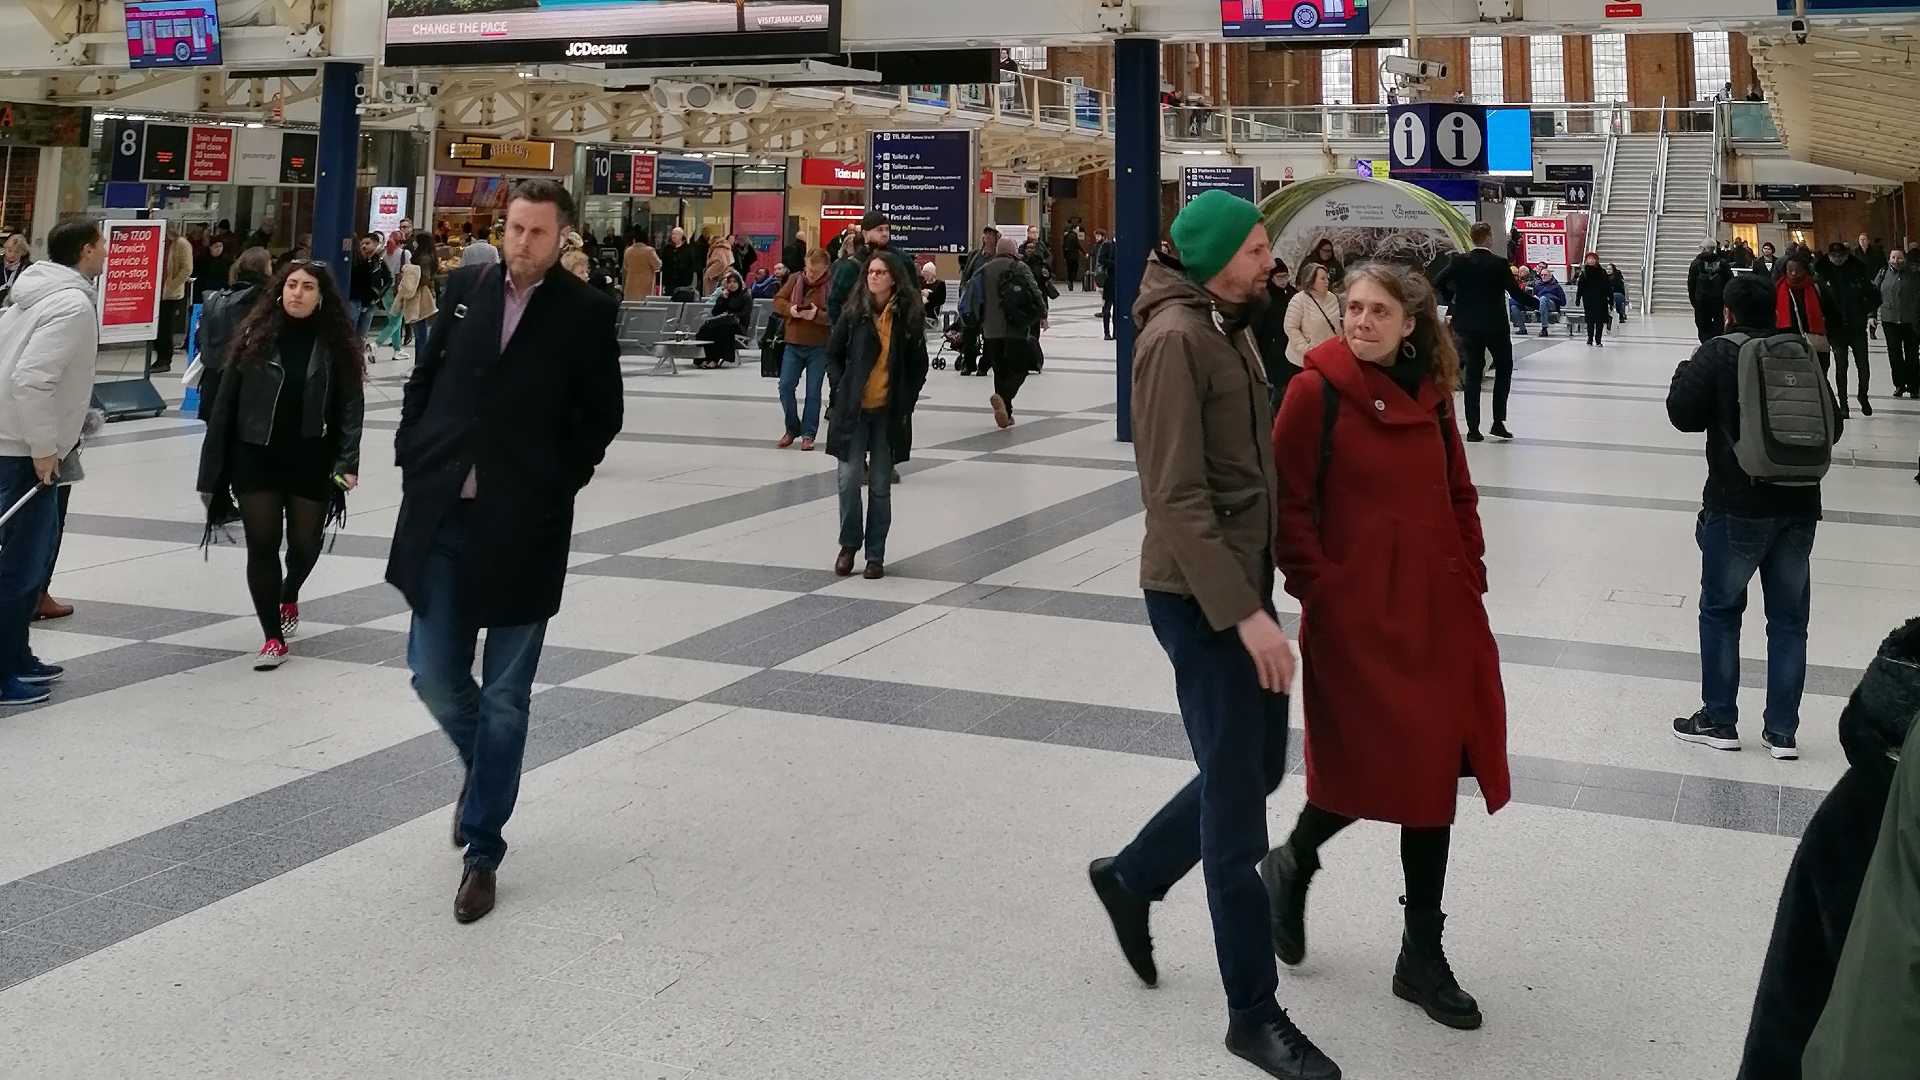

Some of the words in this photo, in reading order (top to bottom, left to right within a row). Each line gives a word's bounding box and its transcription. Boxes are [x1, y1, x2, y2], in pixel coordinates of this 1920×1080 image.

[758, 14, 822, 24] VISITJAMAICA.COM
[412, 23, 455, 35] CHANGE
[459, 22, 478, 34] THE
[480, 21, 508, 32] PACE
[566, 42, 628, 56] JCDecaux
[120, 128, 136, 156] 8
[594, 158, 608, 176] 10
[834, 168, 851, 179] Tickets
[112, 230, 129, 241] The
[110, 242, 146, 254] Norwich
[110, 255, 141, 266] service
[141, 255, 149, 265] is
[108, 269, 148, 279] non-stop
[107, 281, 117, 291] to
